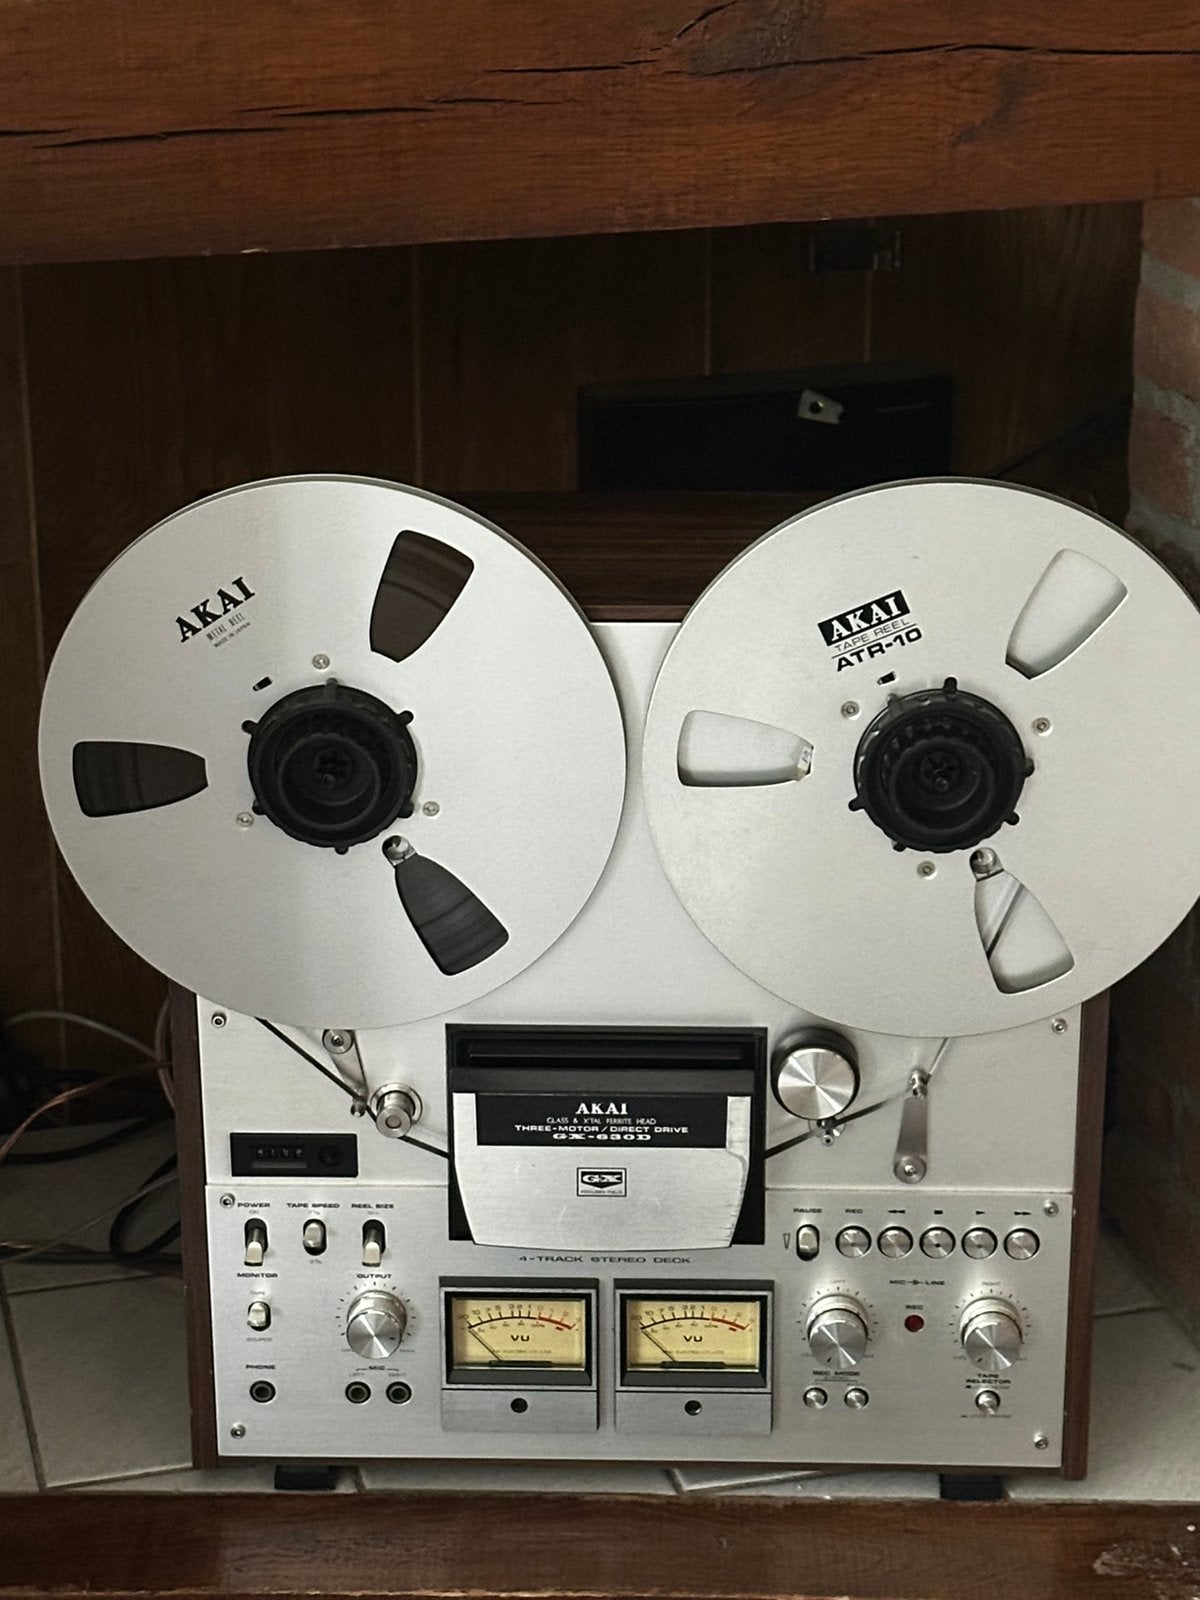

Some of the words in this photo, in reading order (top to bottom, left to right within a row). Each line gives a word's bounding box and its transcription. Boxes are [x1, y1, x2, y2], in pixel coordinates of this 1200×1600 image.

[176, 576, 256, 643] AKAI
[831, 596, 902, 641] AKAI
[834, 633, 870, 653] TAPE
[874, 618, 910, 638] REEL
[836, 627, 922, 672] ATR-10
[576, 1102, 628, 1115] AKAI
[582, 1174, 622, 1183] GX
[510, 1334, 530, 1342] VU
